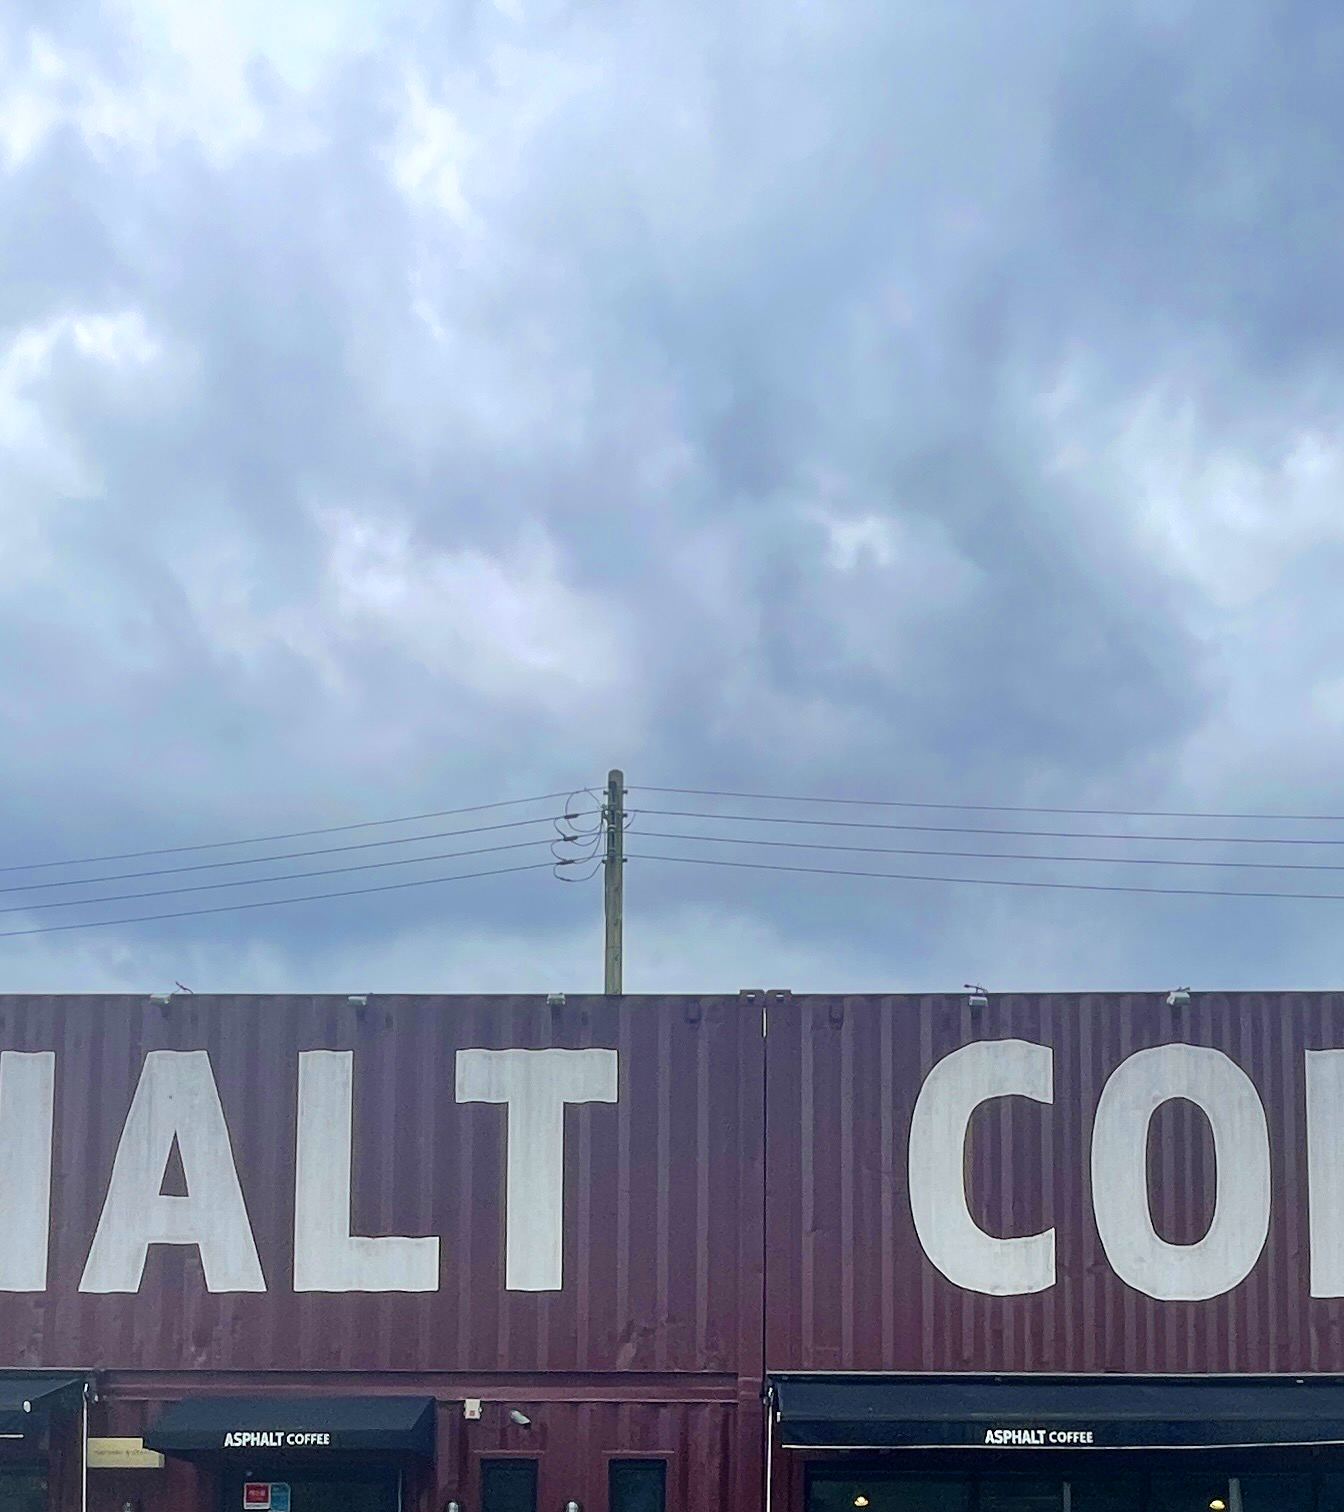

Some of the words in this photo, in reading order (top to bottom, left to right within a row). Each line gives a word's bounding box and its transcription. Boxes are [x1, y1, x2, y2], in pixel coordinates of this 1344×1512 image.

[223, 1431, 284, 1447] ASPHALT
[286, 1433, 331, 1446] COFFEE
[984, 1429, 1047, 1444] ASPHALT
[1048, 1430, 1094, 1443] COFFEE
